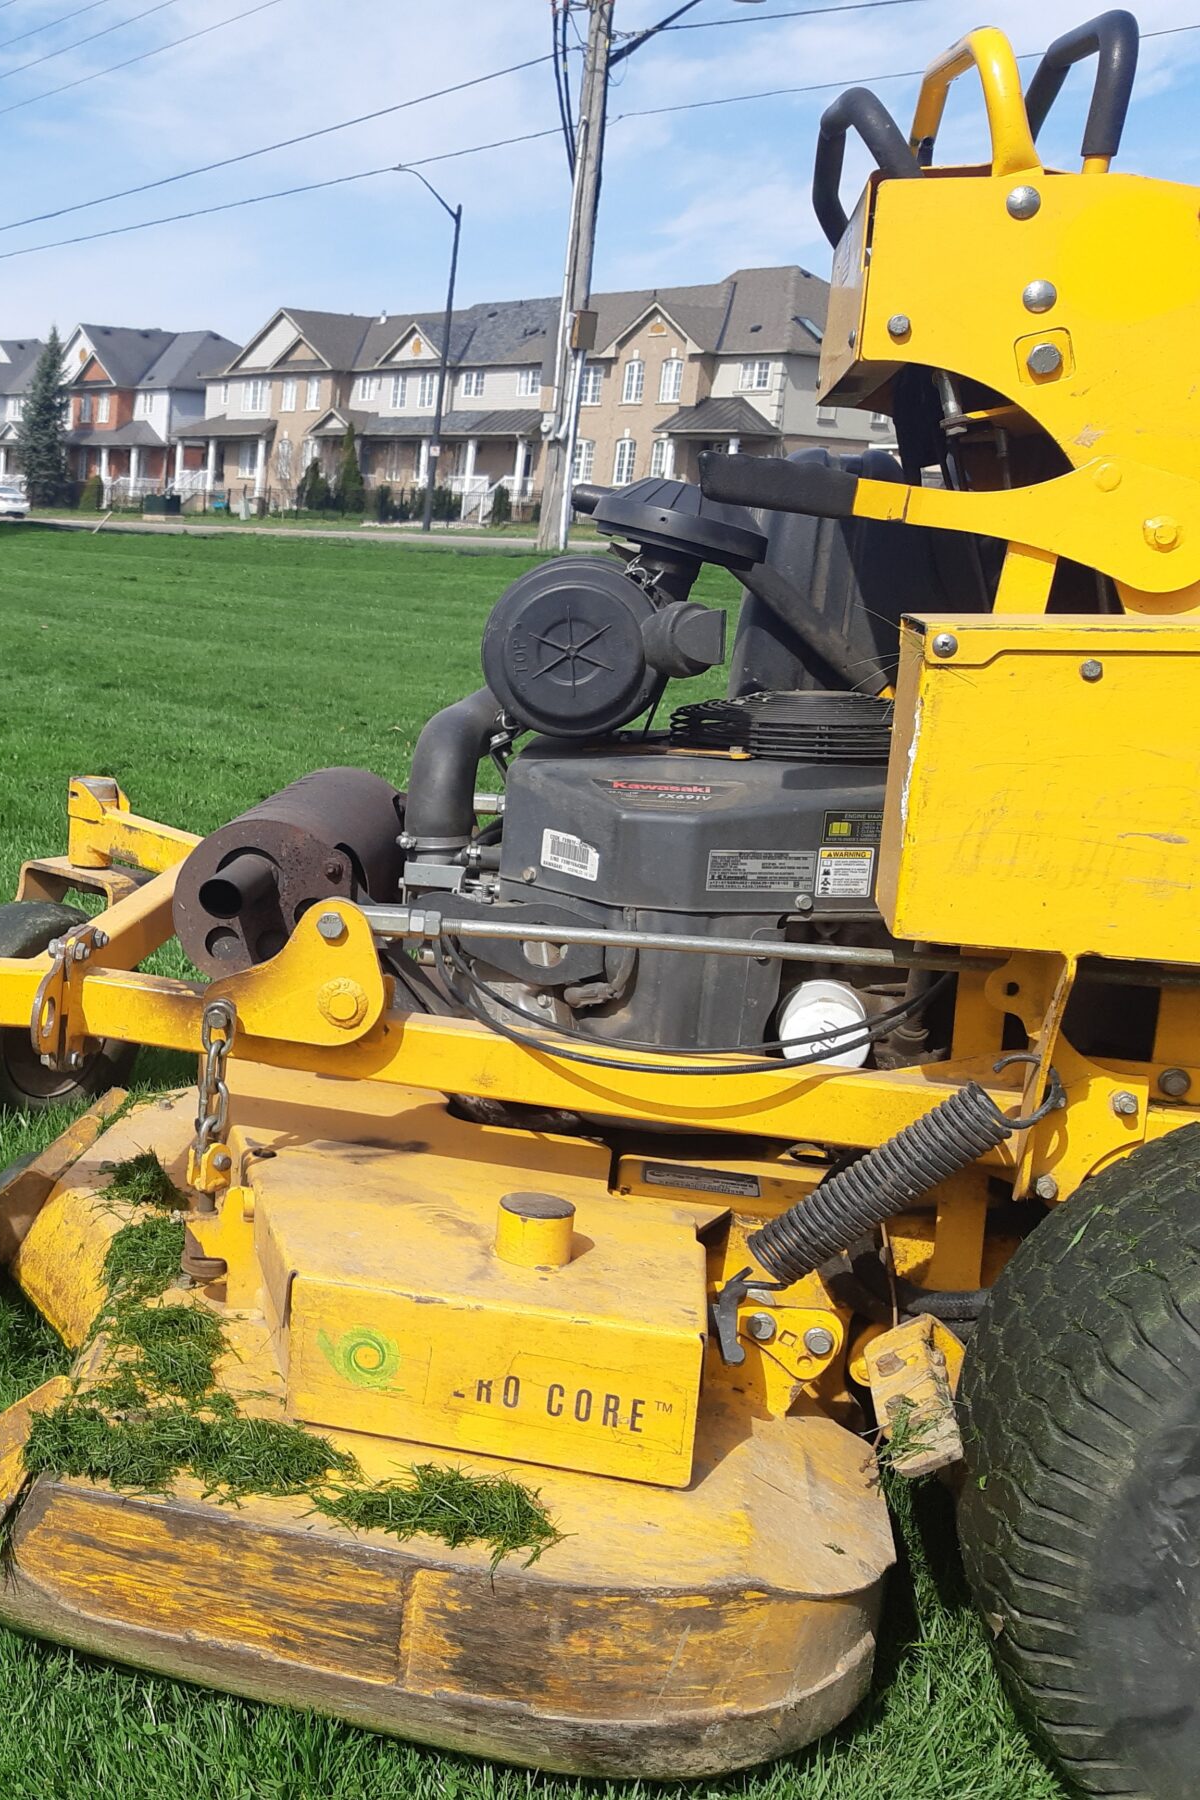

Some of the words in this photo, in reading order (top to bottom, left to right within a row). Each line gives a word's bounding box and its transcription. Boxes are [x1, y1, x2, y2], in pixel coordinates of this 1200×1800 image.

[612, 781, 711, 793] Kawasaki
[657, 793, 712, 801] FX691V
[453, 1375, 520, 1409] RO
[546, 1383, 646, 1433] CORE
